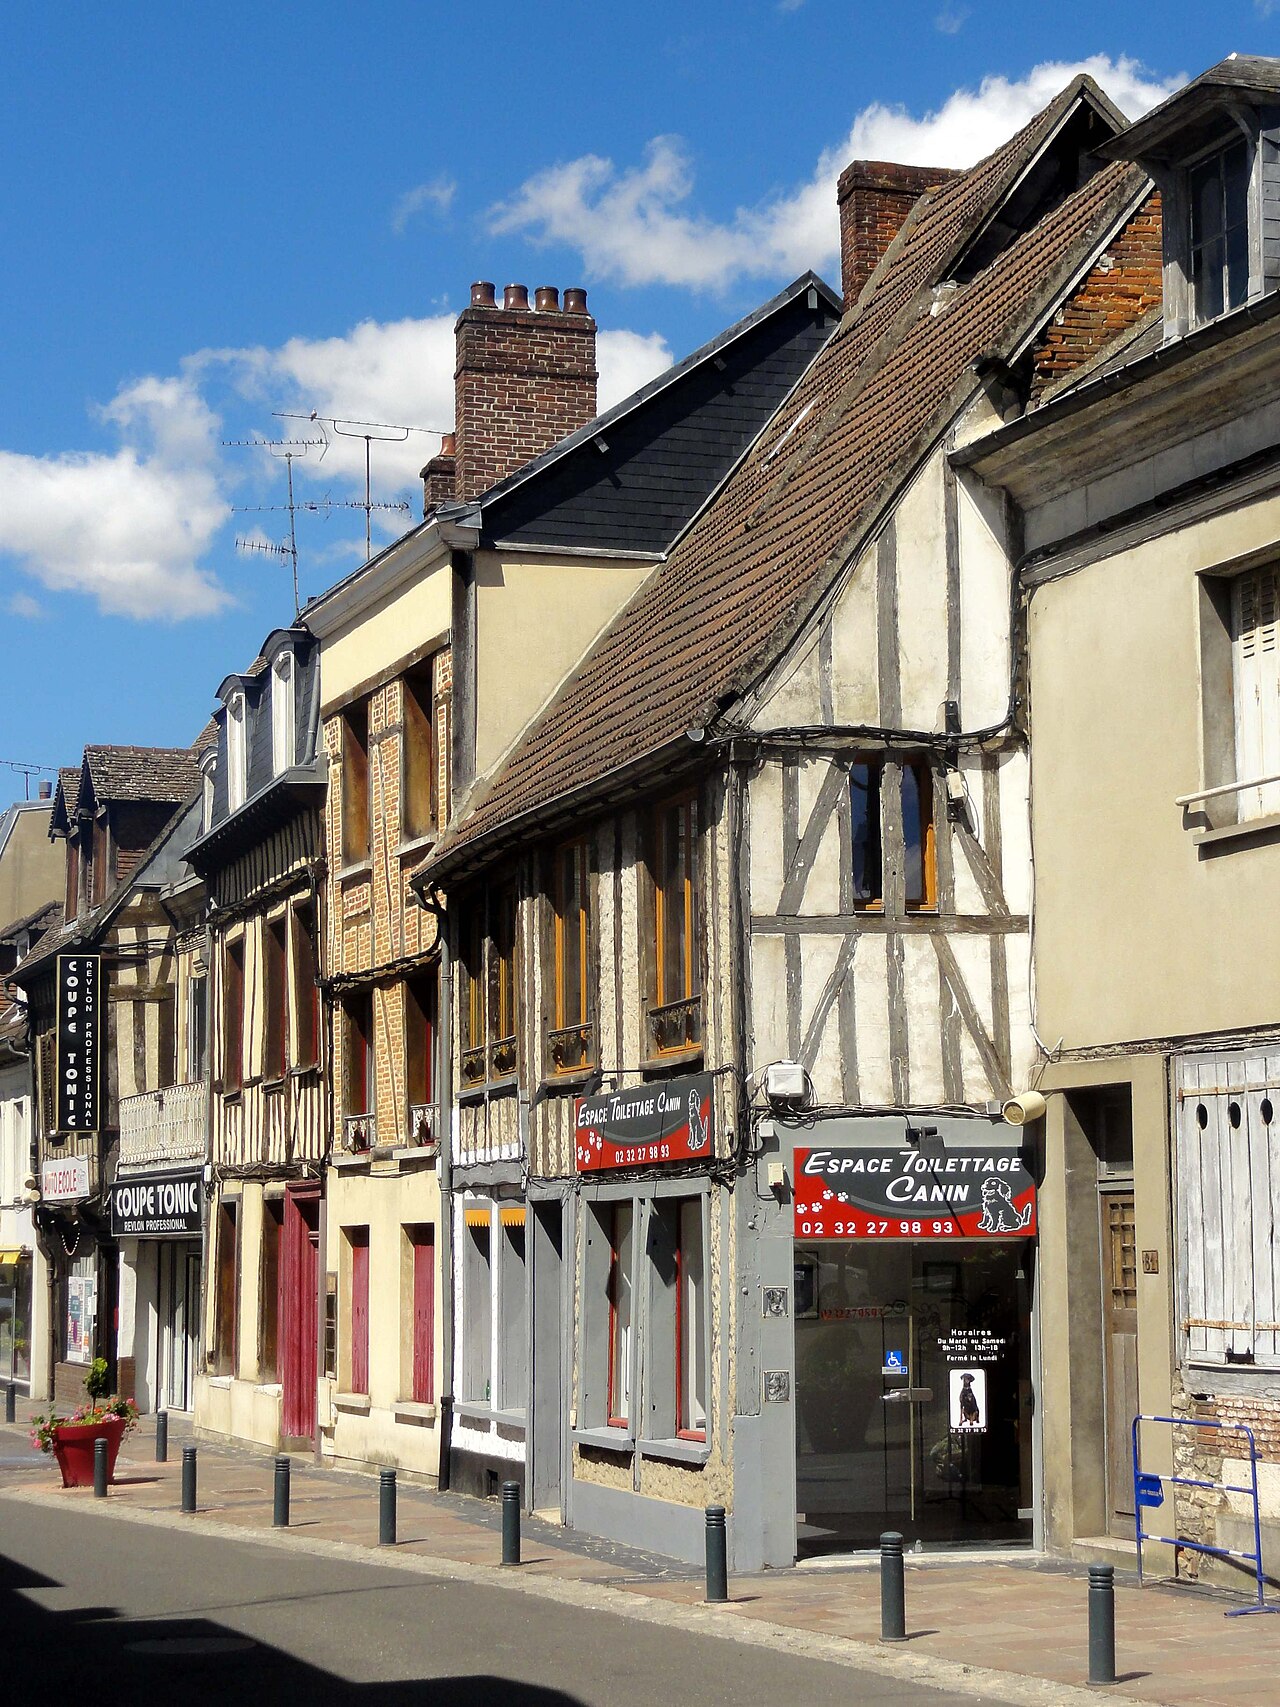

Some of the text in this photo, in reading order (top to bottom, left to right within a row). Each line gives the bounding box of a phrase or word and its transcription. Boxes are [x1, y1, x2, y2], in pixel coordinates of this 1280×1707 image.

[65, 961, 79, 1126] COUPE TONIC
[84, 961, 93, 1126] REVLON PROFESSIONAL
[578, 1092, 681, 1127] ESPACE TOILETTAGE CANIN
[615, 1144, 669, 1164] 02 32 27 98 93
[804, 1150, 1022, 1174] ESPACE TOILETTAGE
[58, 1168, 77, 1194] ECOLE
[885, 1175, 969, 1202] CANIN
[116, 1182, 198, 1218] COUPE TONIC
[124, 1218, 187, 1232] REVLON PROFESSIONAL
[801, 1222, 953, 1234] 02 32 27 98 93
[951, 1328, 992, 1336] Horaires
